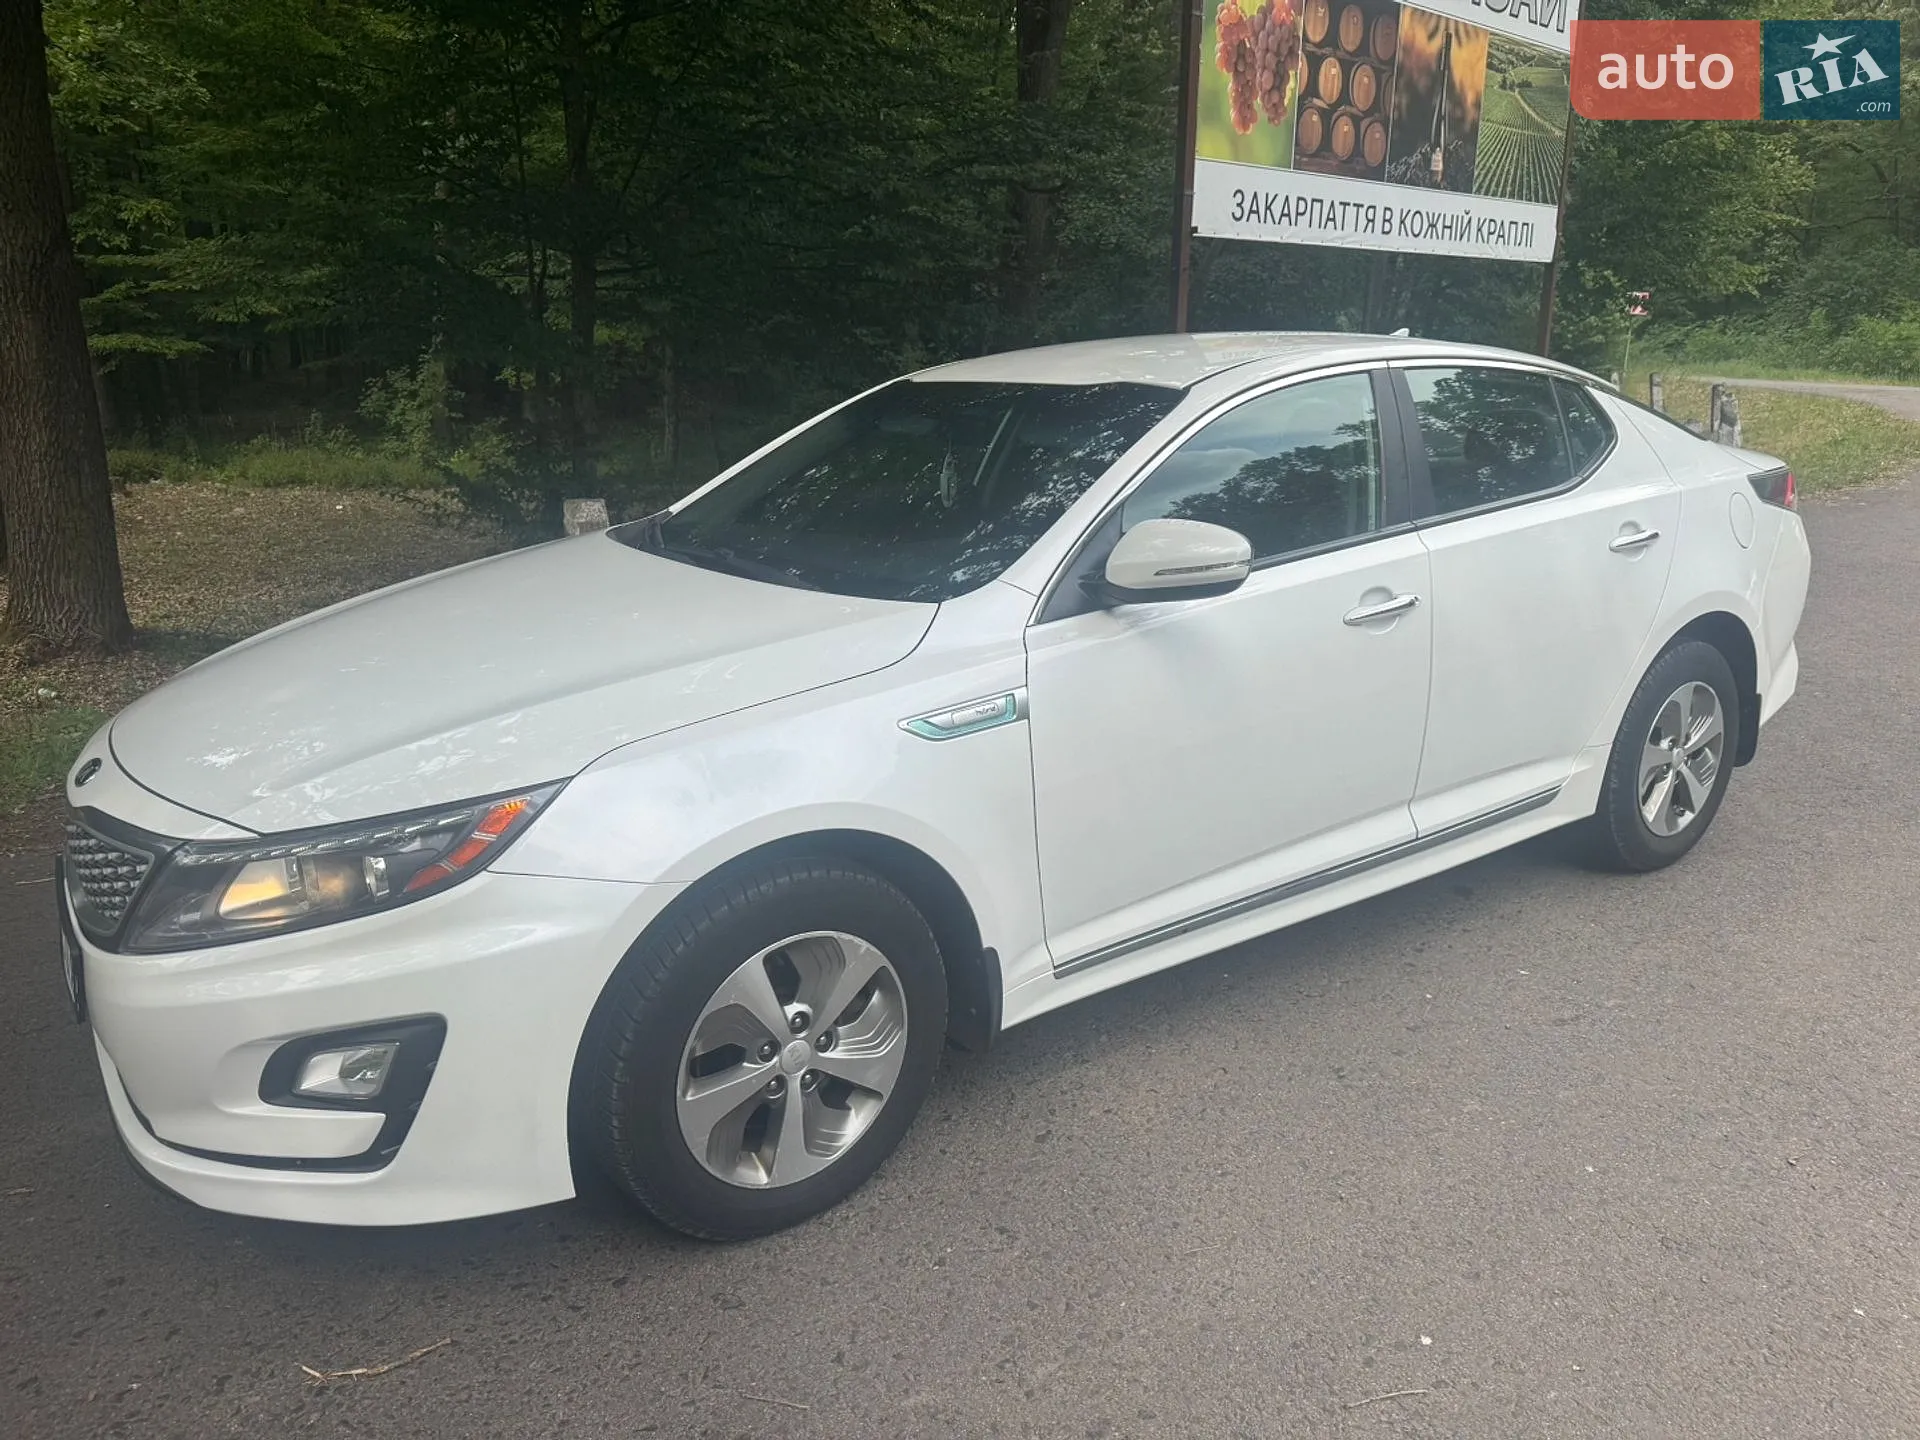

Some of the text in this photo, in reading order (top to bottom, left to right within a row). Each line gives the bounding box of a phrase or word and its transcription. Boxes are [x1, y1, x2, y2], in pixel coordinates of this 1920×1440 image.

[1231, 189, 1535, 249] ЗАКАРПАТТЯ В КОЖНІЙ КРАПЛІ
